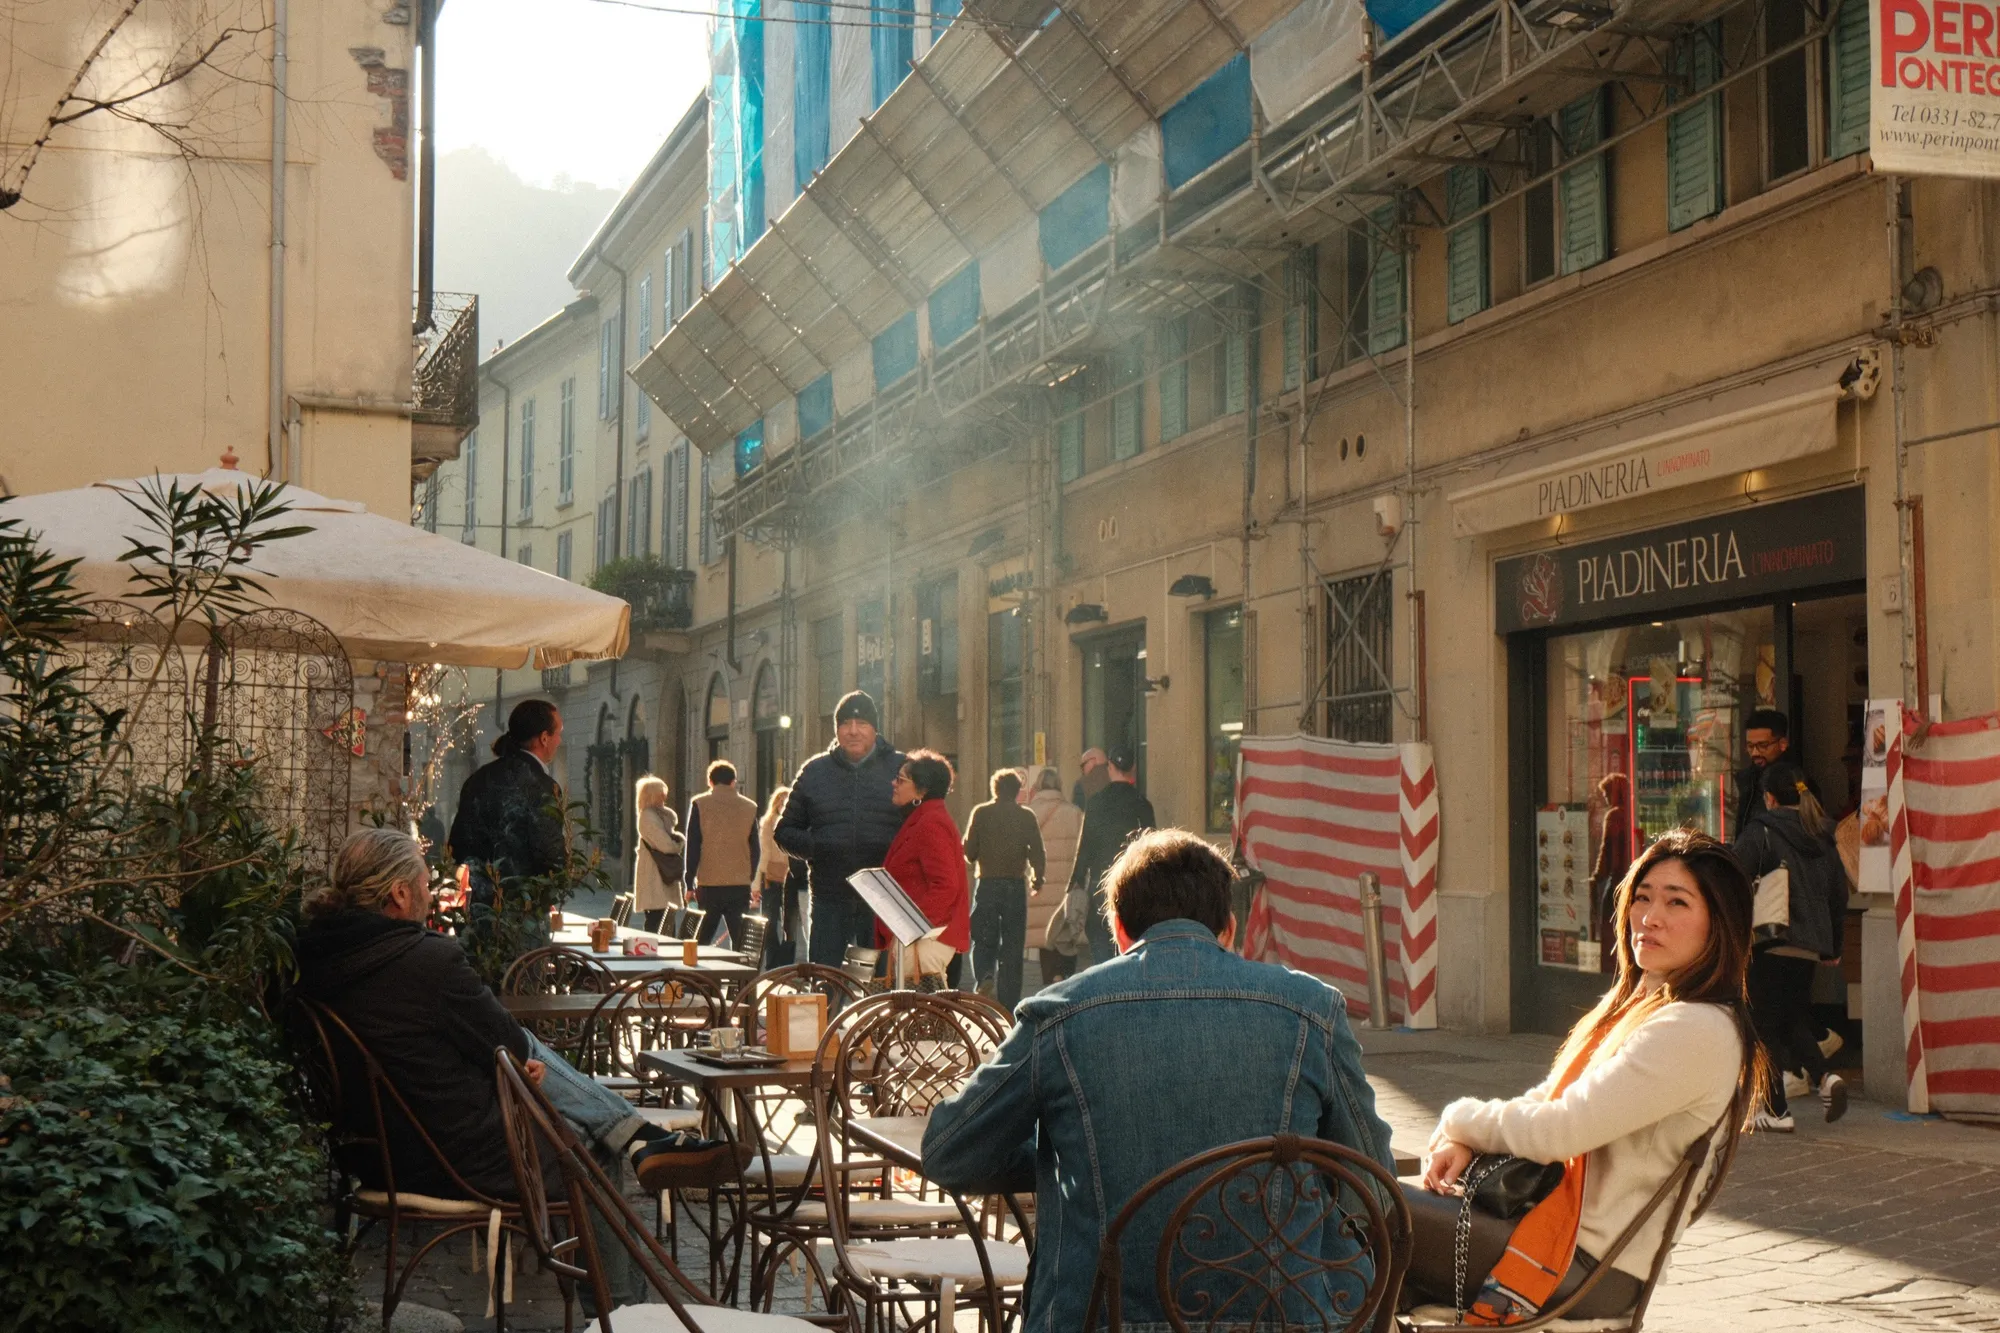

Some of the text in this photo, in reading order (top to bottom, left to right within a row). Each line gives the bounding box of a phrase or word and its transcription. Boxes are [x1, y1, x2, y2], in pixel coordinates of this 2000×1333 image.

[1891, 104, 1915, 124] Tel
[1538, 457, 1651, 516] PIADINERIA
[1578, 529, 1747, 605] PIADINERIA
